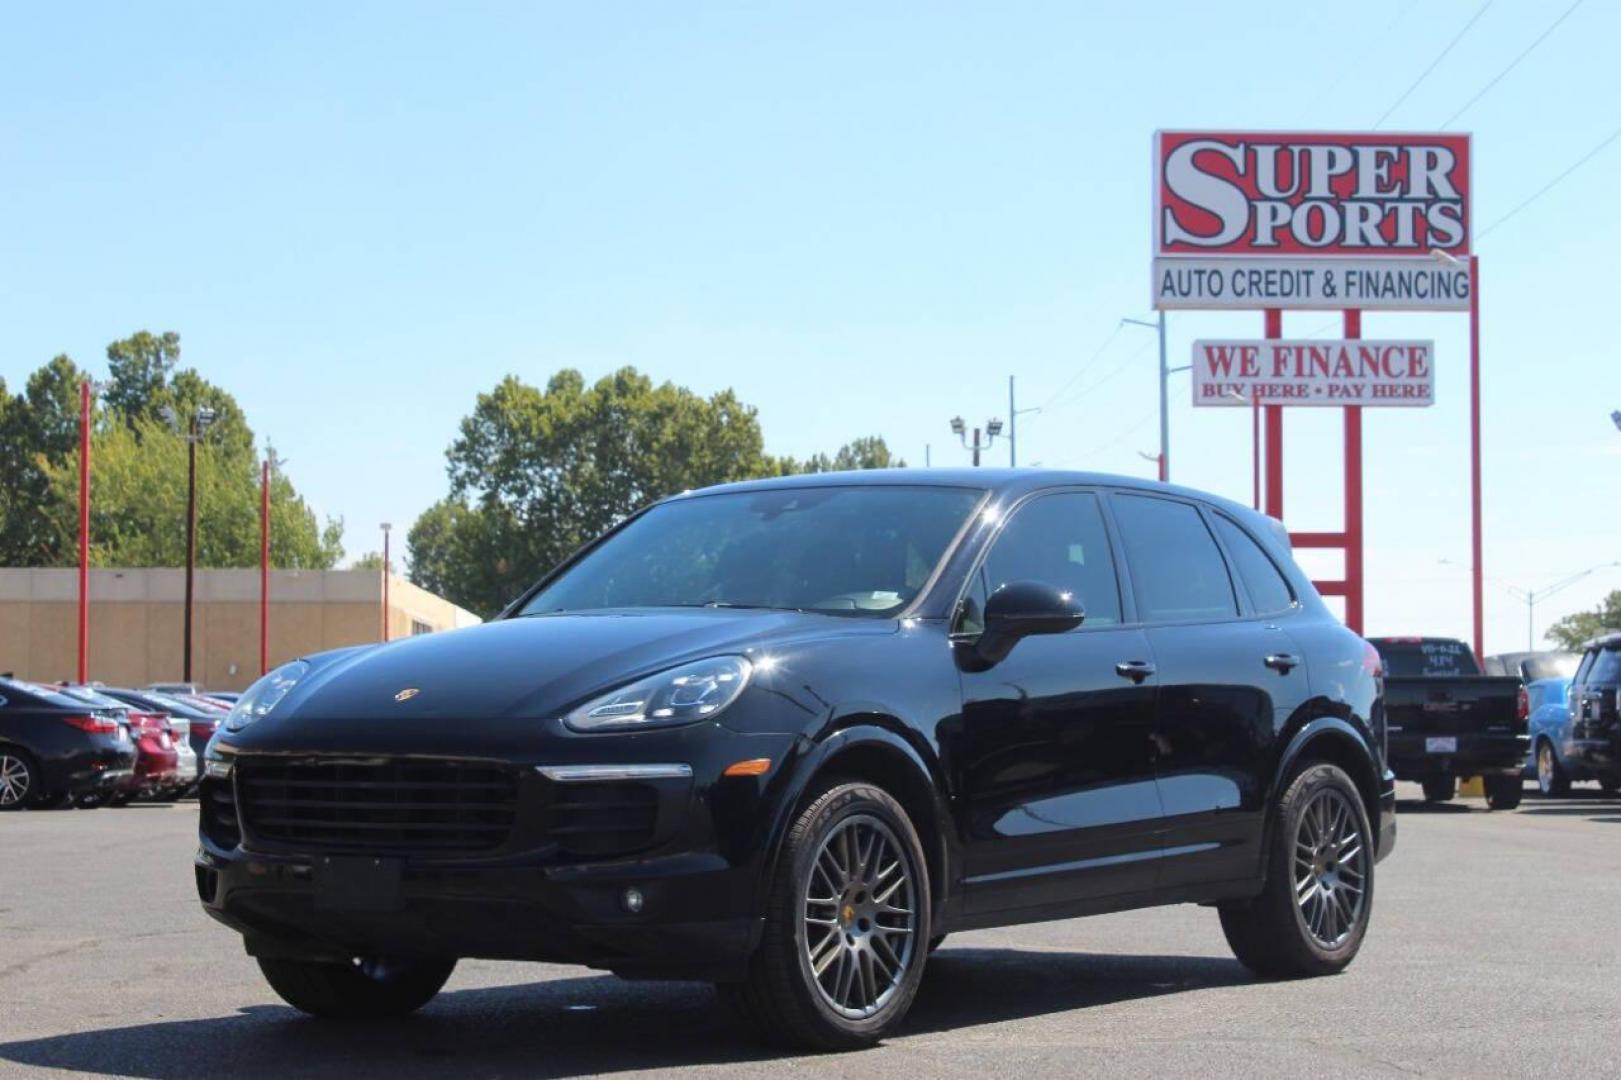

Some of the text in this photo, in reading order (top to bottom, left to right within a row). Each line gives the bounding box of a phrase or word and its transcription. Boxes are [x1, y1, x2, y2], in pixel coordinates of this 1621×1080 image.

[1163, 138, 1462, 248] SUPER
[1161, 269, 1470, 299] AUTO CREDIT & FINANCING
[1203, 346, 1429, 378] WE FINANCE
[1202, 383, 1431, 399] BUY HERE PAY HERE
